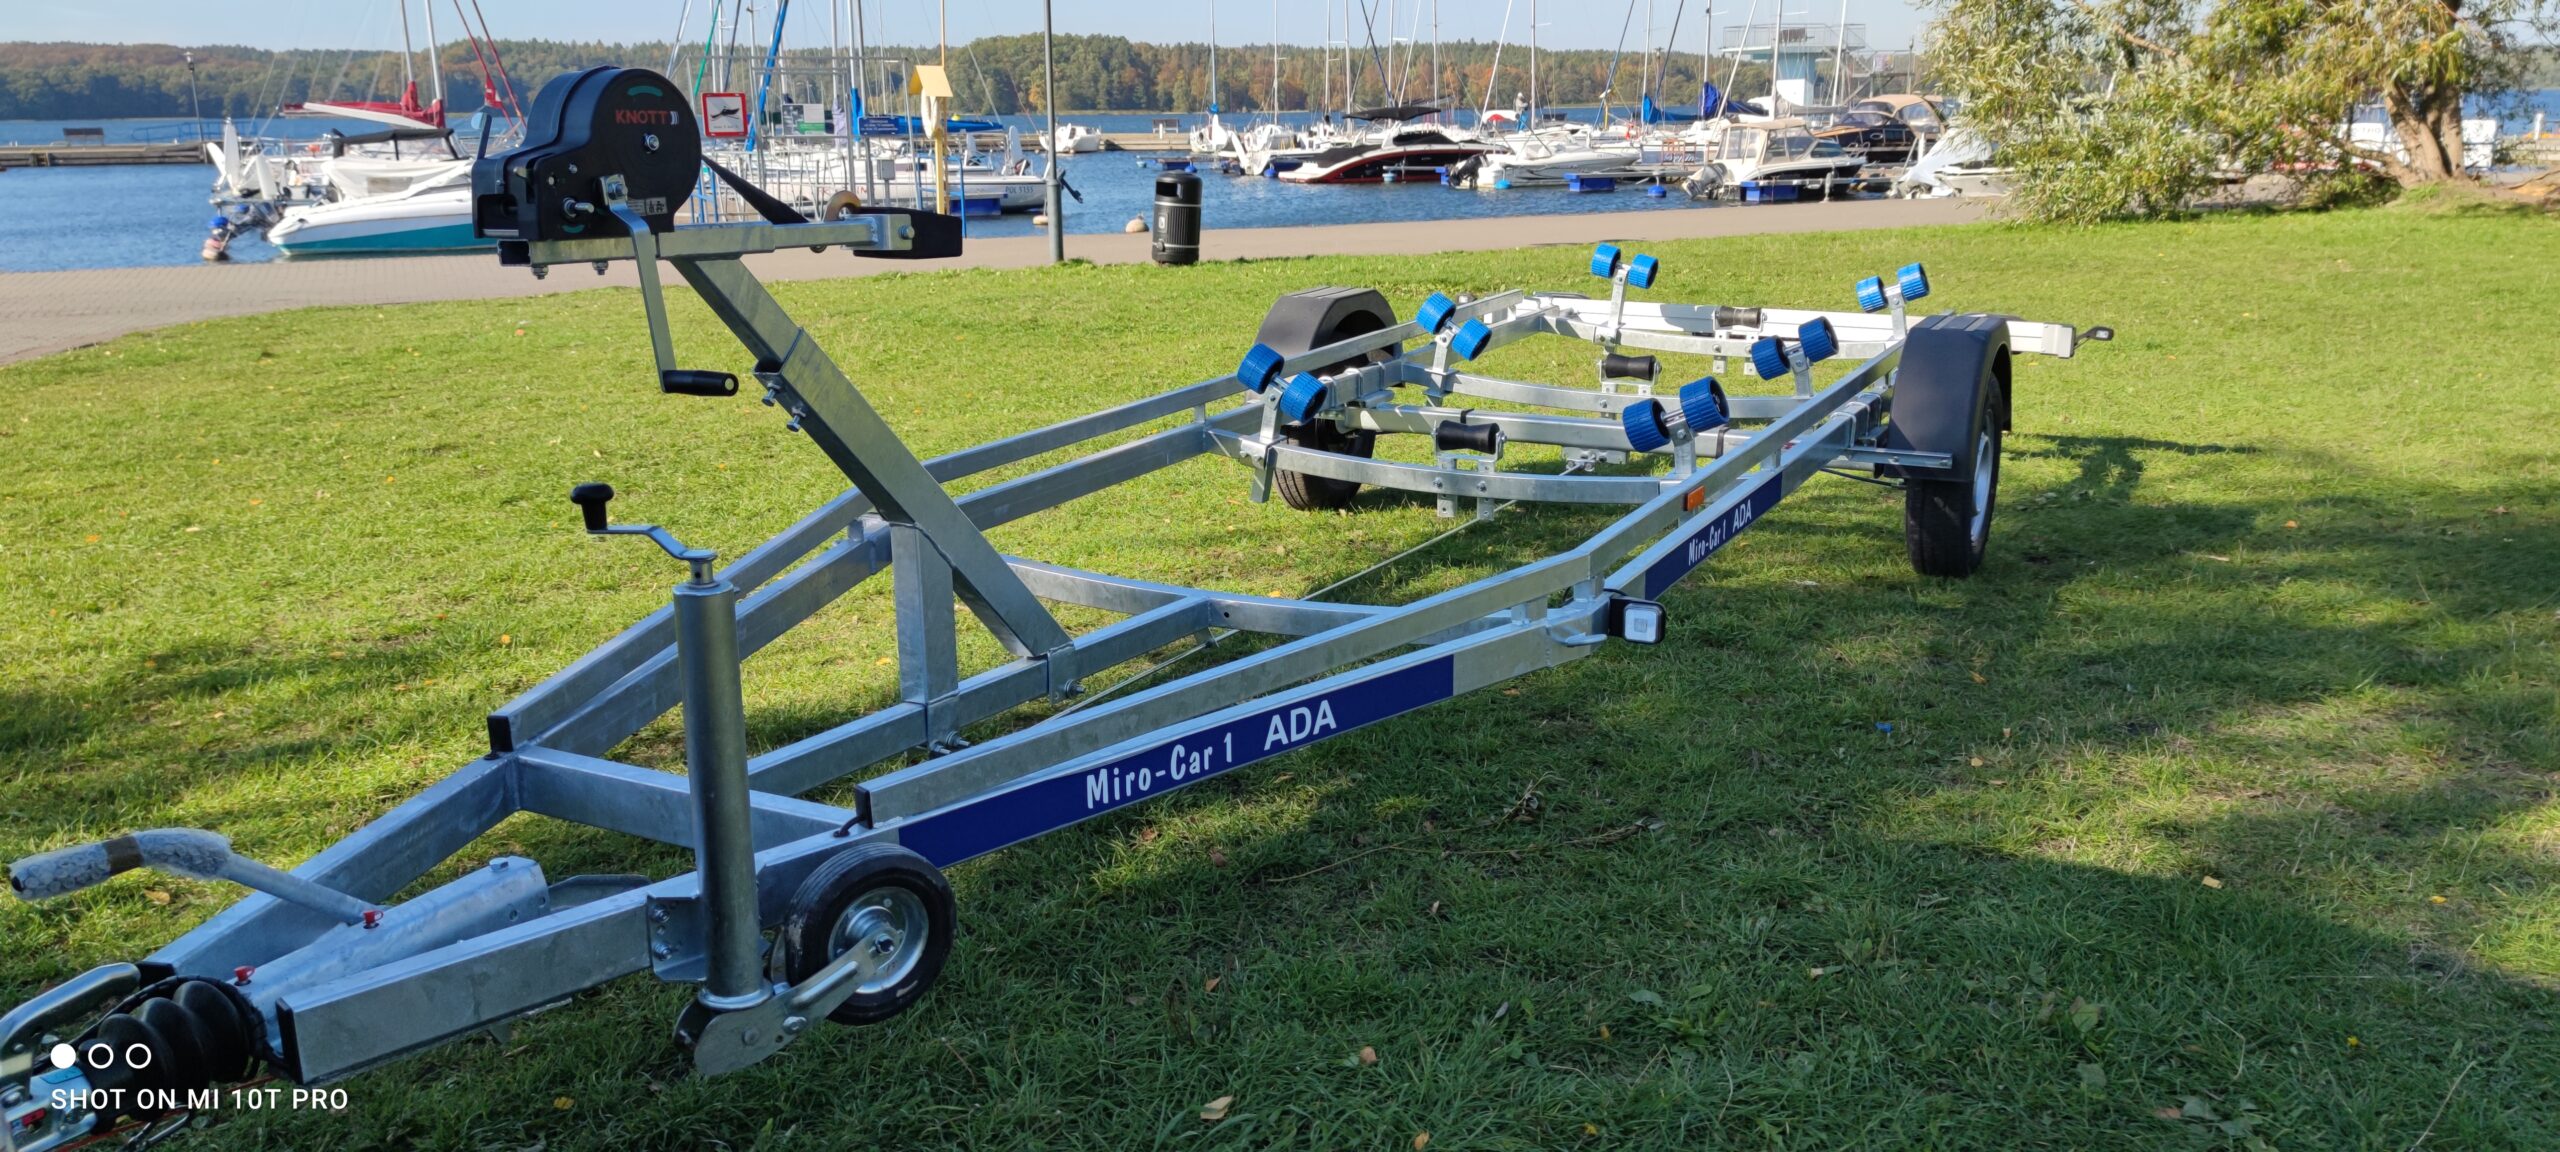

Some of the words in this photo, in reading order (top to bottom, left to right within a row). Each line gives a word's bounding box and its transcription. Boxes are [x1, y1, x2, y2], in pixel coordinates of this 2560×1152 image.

[615, 110, 669, 124] KNOTT
[1688, 525, 1721, 566] Miro-Car
[1732, 499, 1752, 533] ADA
[1086, 744, 1213, 809] Miro-Car
[1223, 732, 1233, 763] 1
[1263, 699, 1337, 751] ADA
